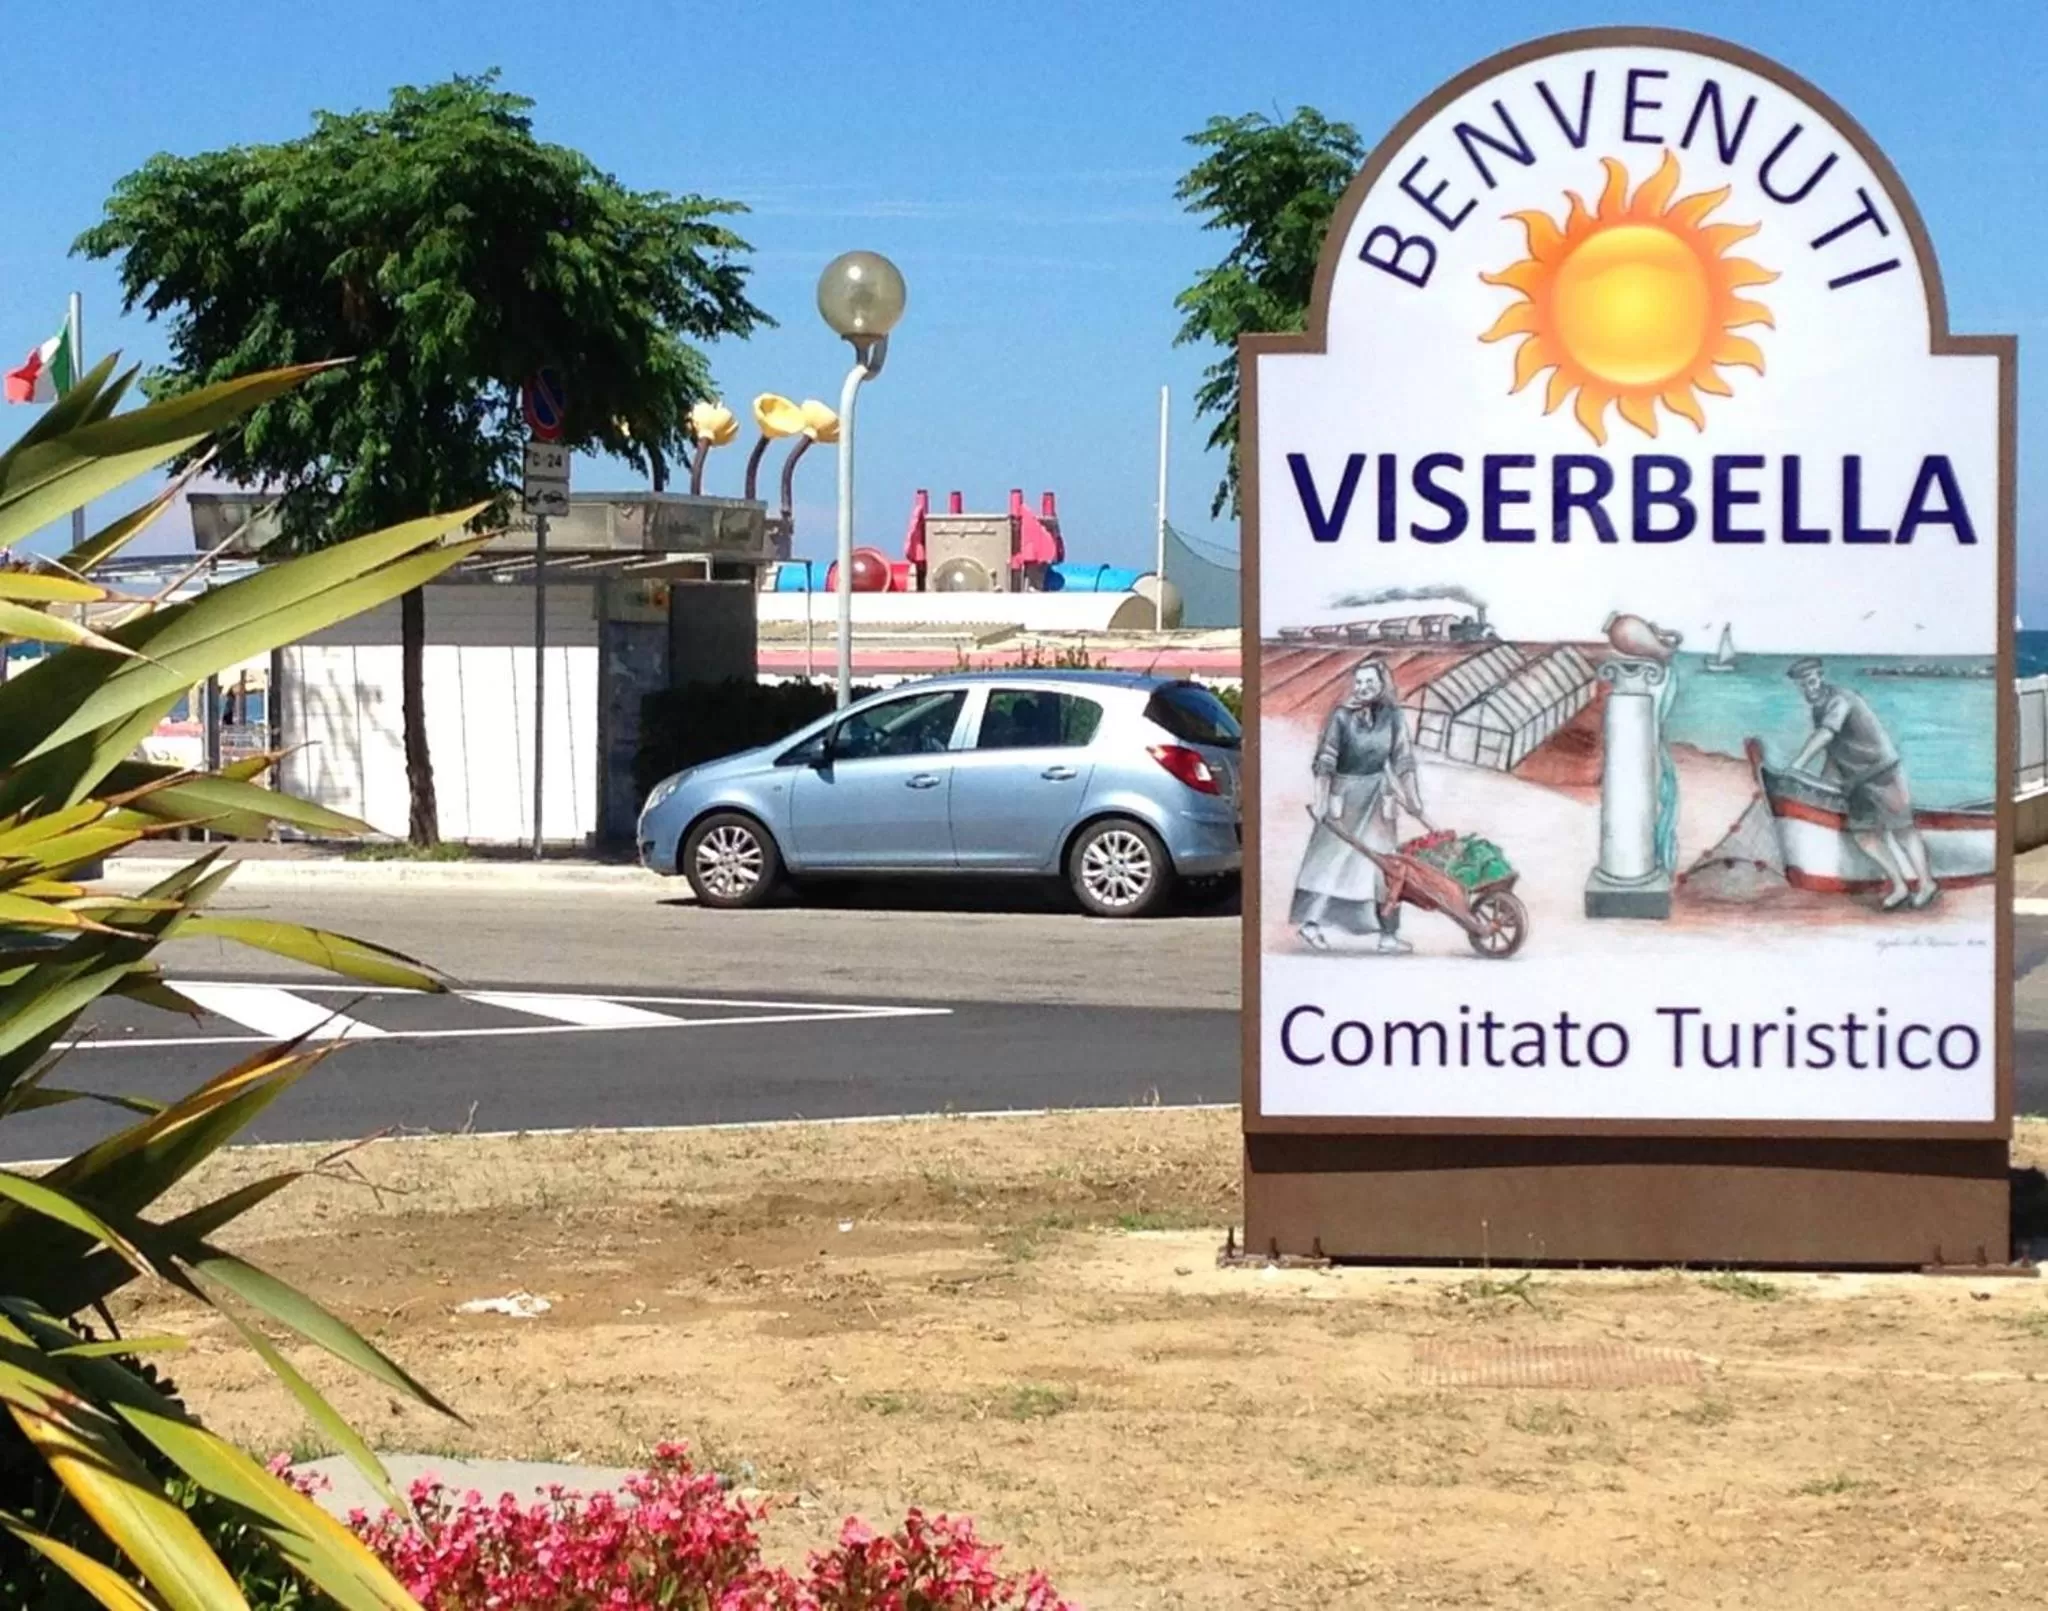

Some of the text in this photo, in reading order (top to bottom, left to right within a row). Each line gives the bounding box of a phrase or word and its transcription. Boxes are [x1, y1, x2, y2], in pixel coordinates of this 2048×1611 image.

[1358, 68, 1901, 290] BENVENUTI
[1286, 452, 1978, 545] VISERBELLA
[1280, 1004, 1980, 1070] Comitato Turistico
